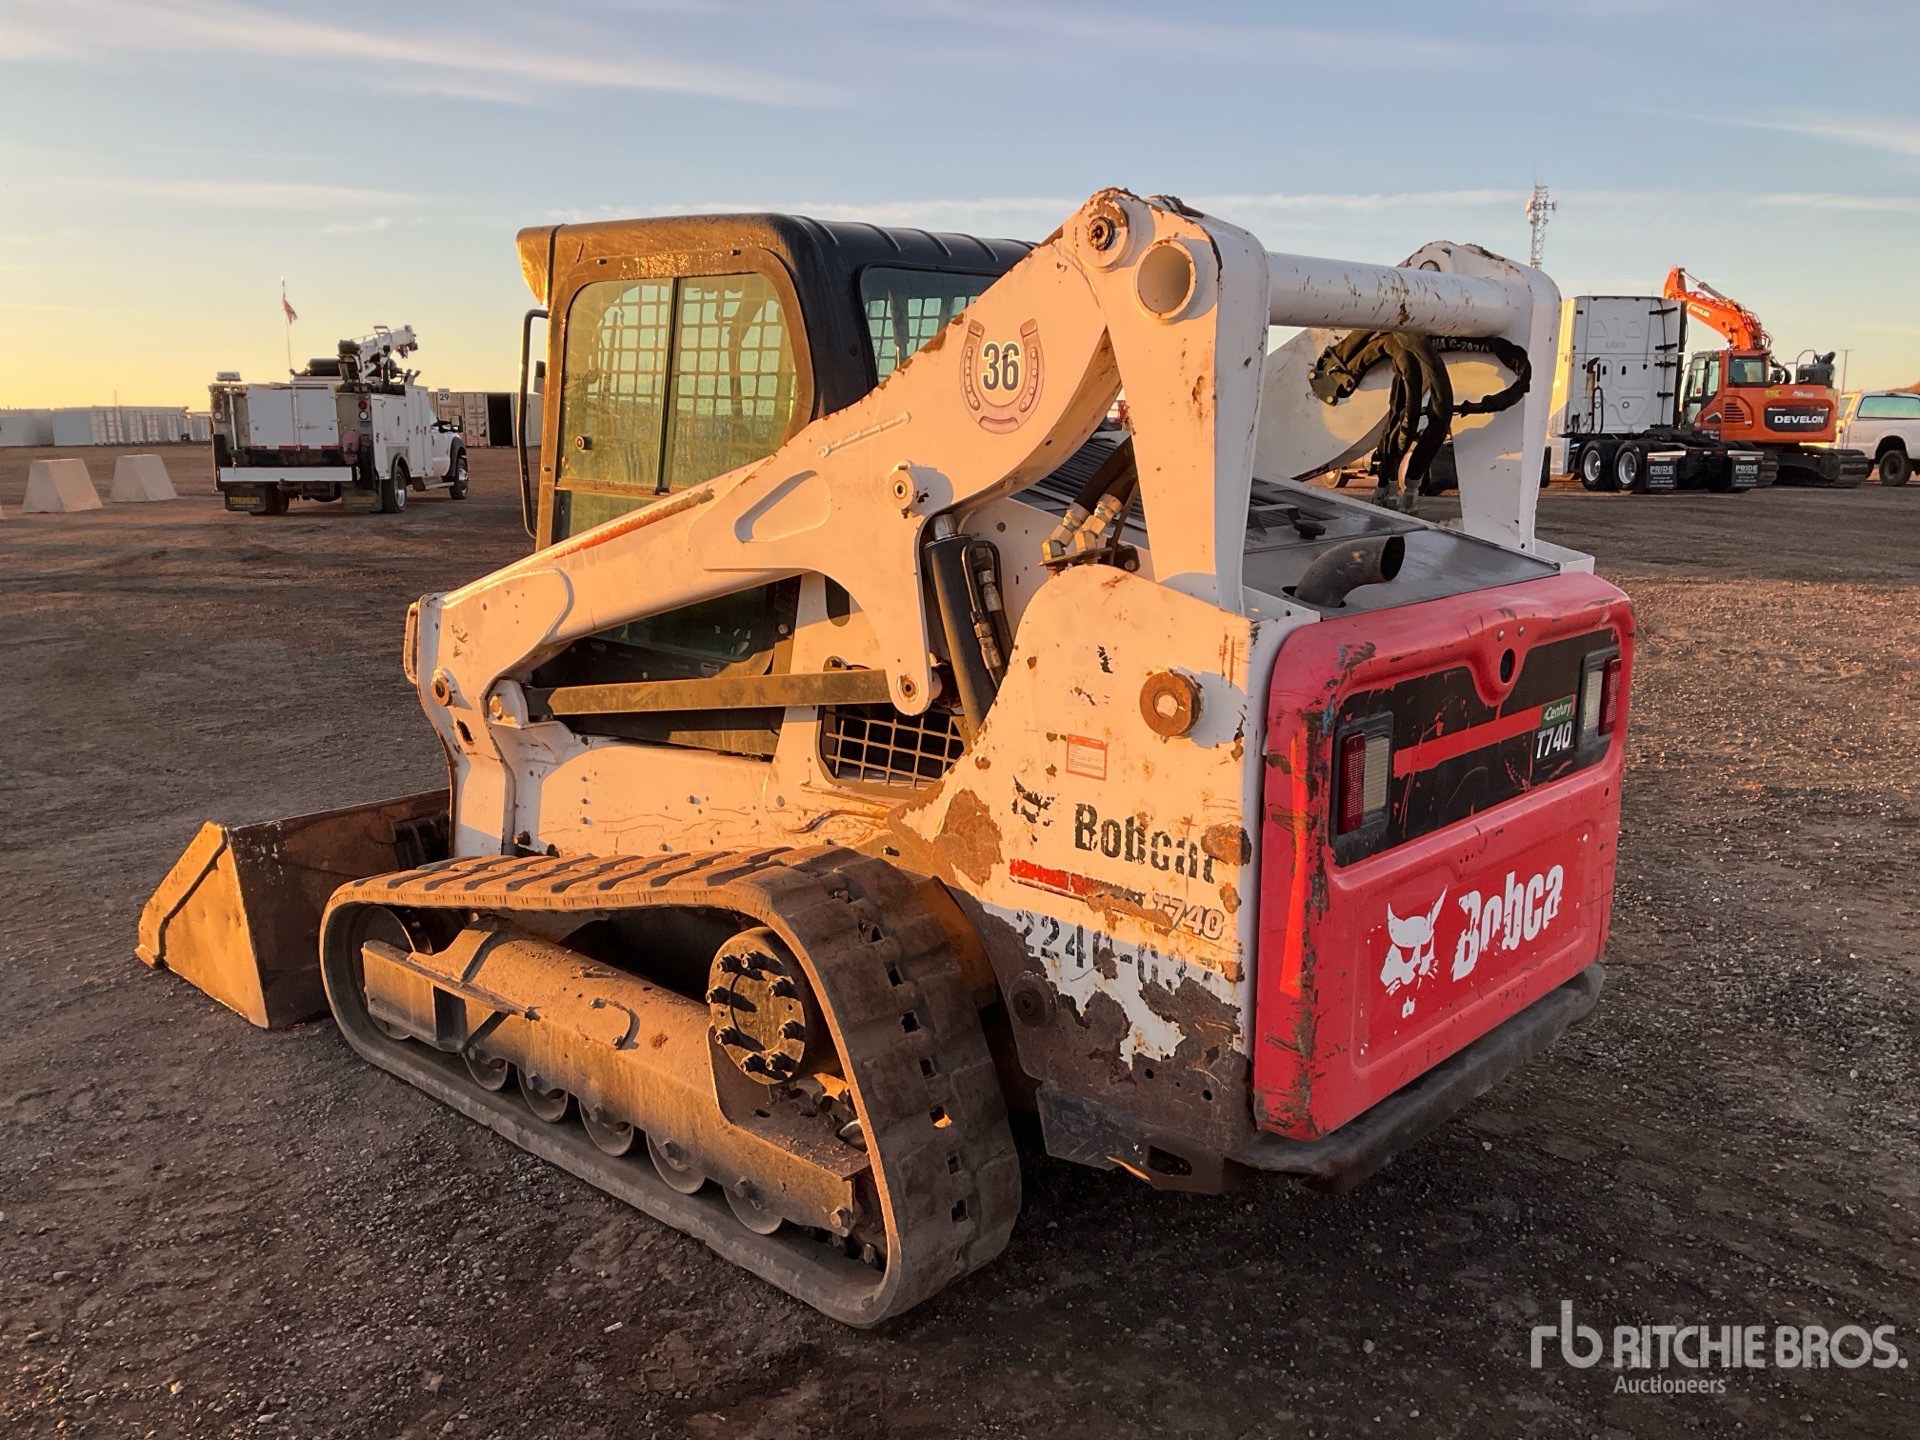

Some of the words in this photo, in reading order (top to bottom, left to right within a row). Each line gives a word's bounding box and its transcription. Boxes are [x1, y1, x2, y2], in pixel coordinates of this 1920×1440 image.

[982, 342, 1020, 391] 36
[439, 393, 450, 401] 29
[1774, 415, 1824, 424] DEVELON
[1543, 702, 1573, 721] Century
[1536, 720, 1572, 759] T740
